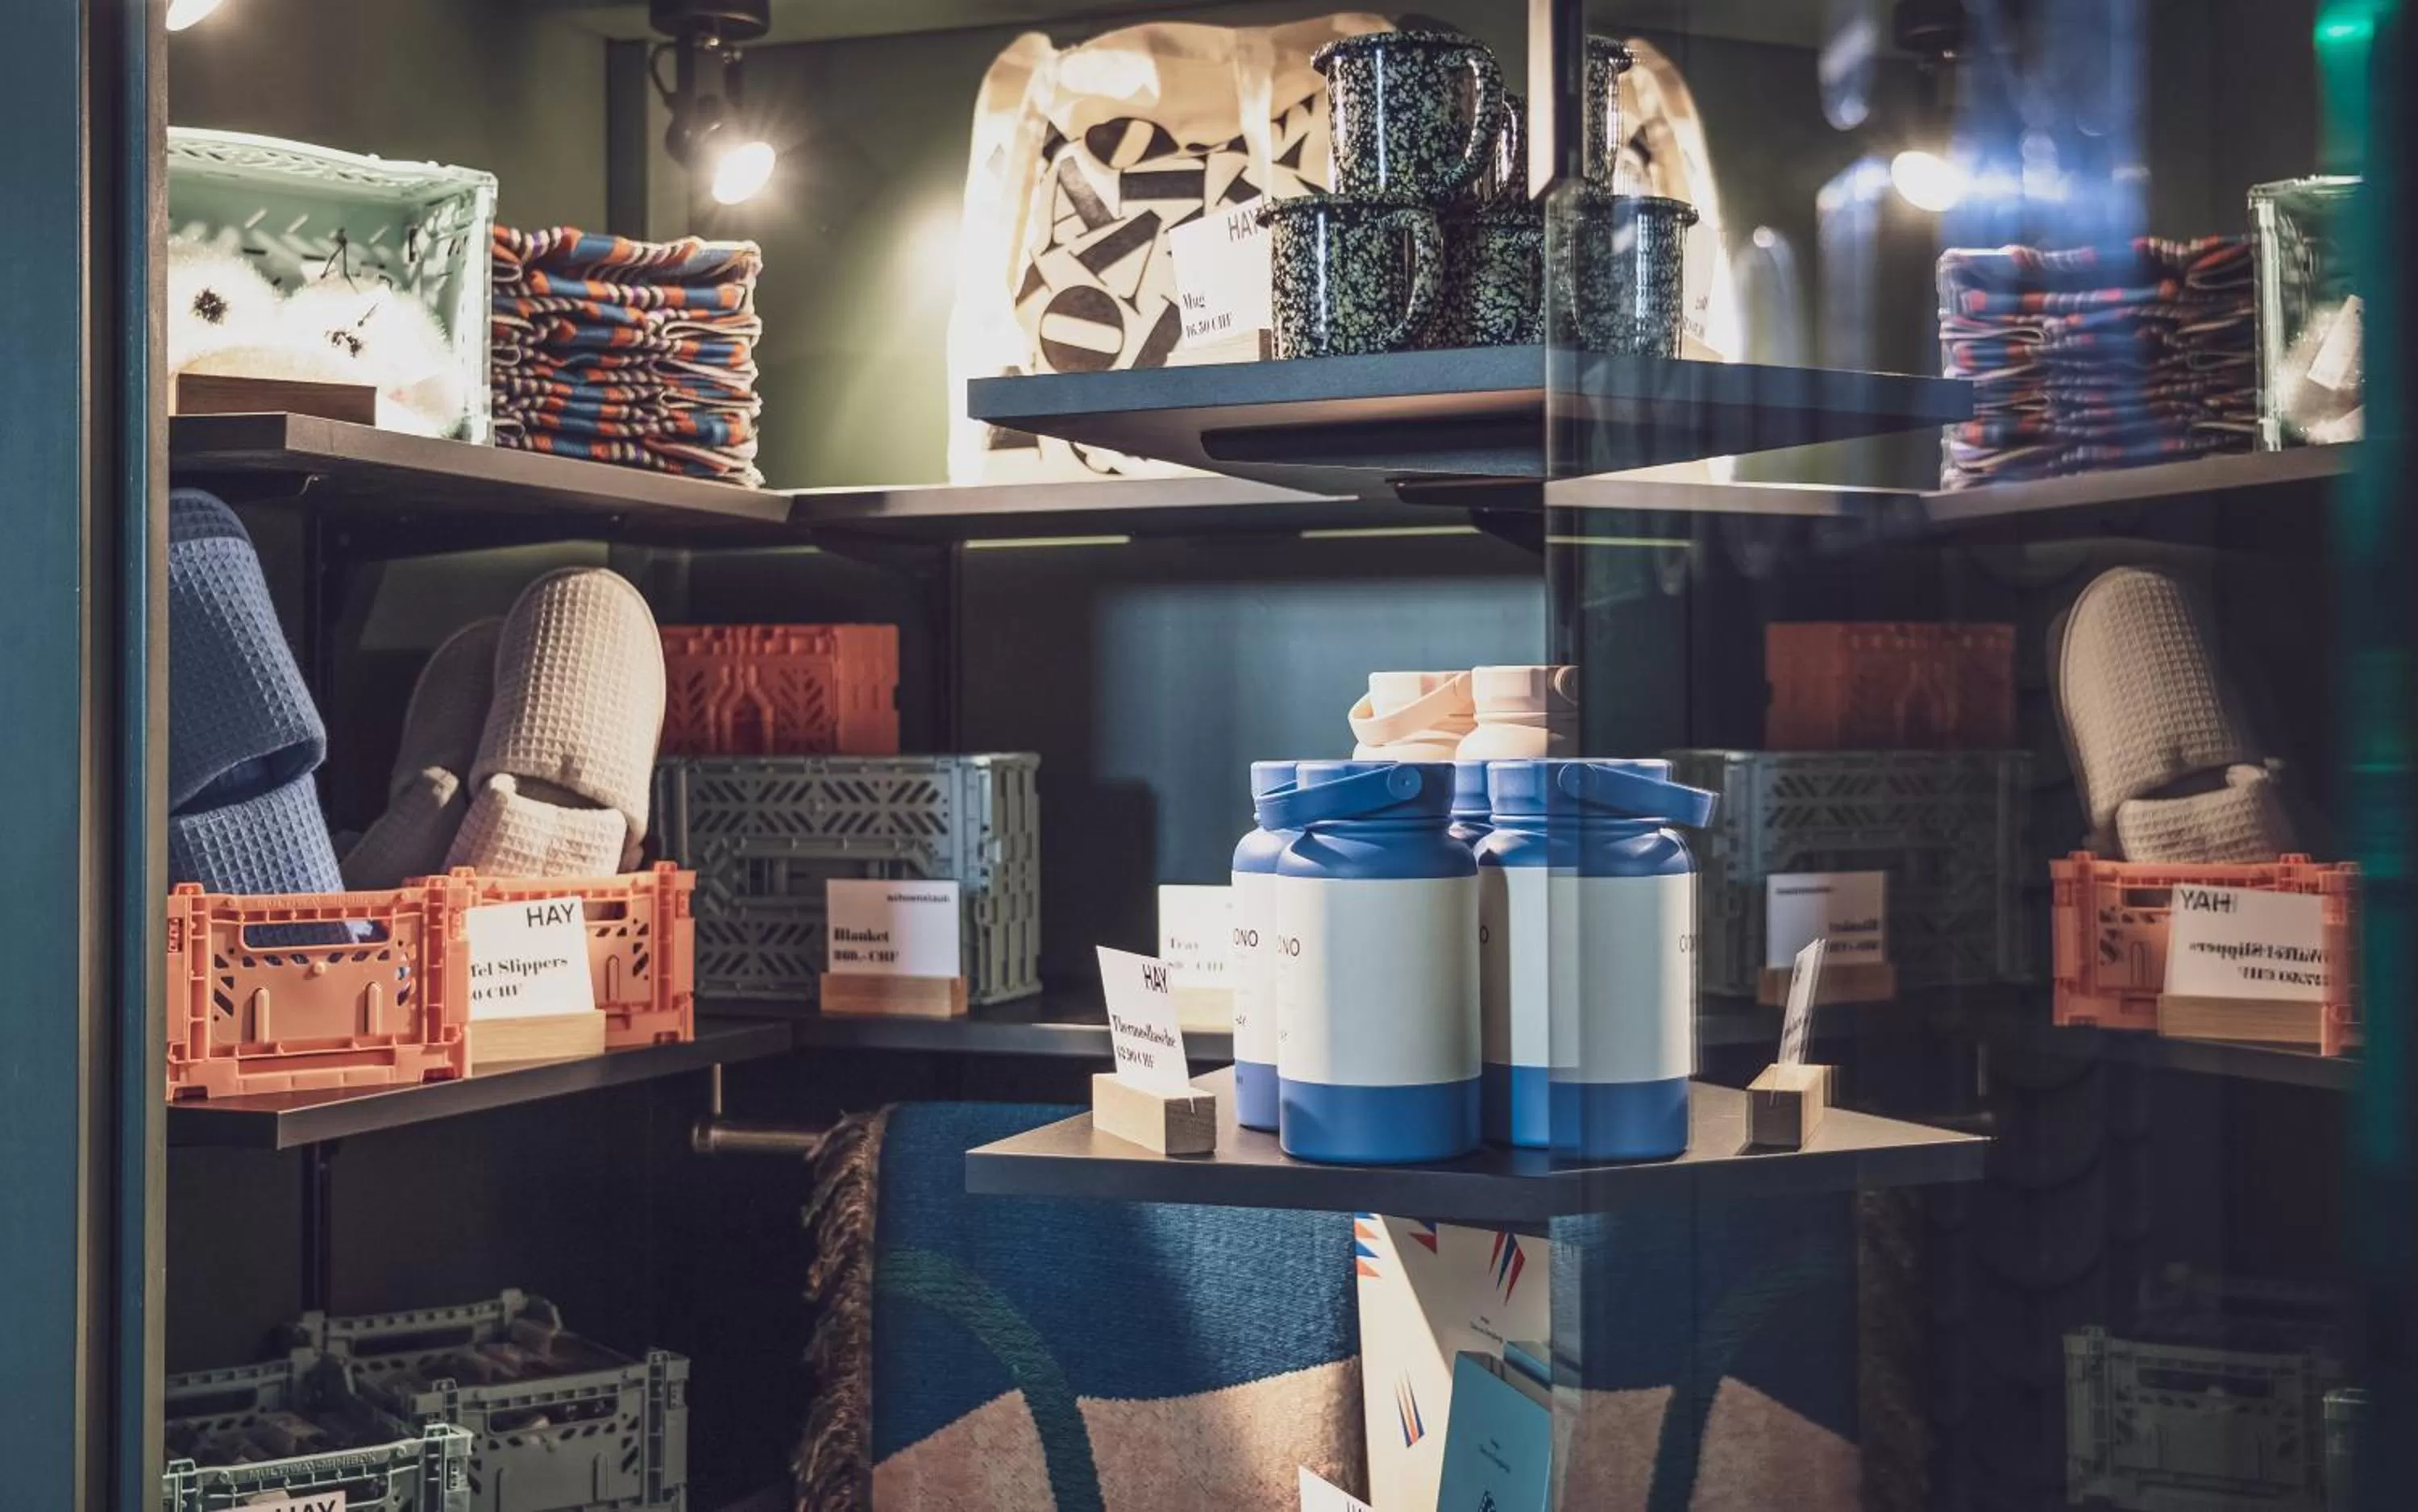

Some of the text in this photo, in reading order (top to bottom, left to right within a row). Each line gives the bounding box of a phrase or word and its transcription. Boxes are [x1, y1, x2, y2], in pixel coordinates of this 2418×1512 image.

[1182, 293, 1206, 309] Mug
[526, 903, 574, 928] HAY
[834, 928, 889, 942] Blanket
[497, 957, 568, 977] Slippers
[1142, 963, 1168, 994] HAY
